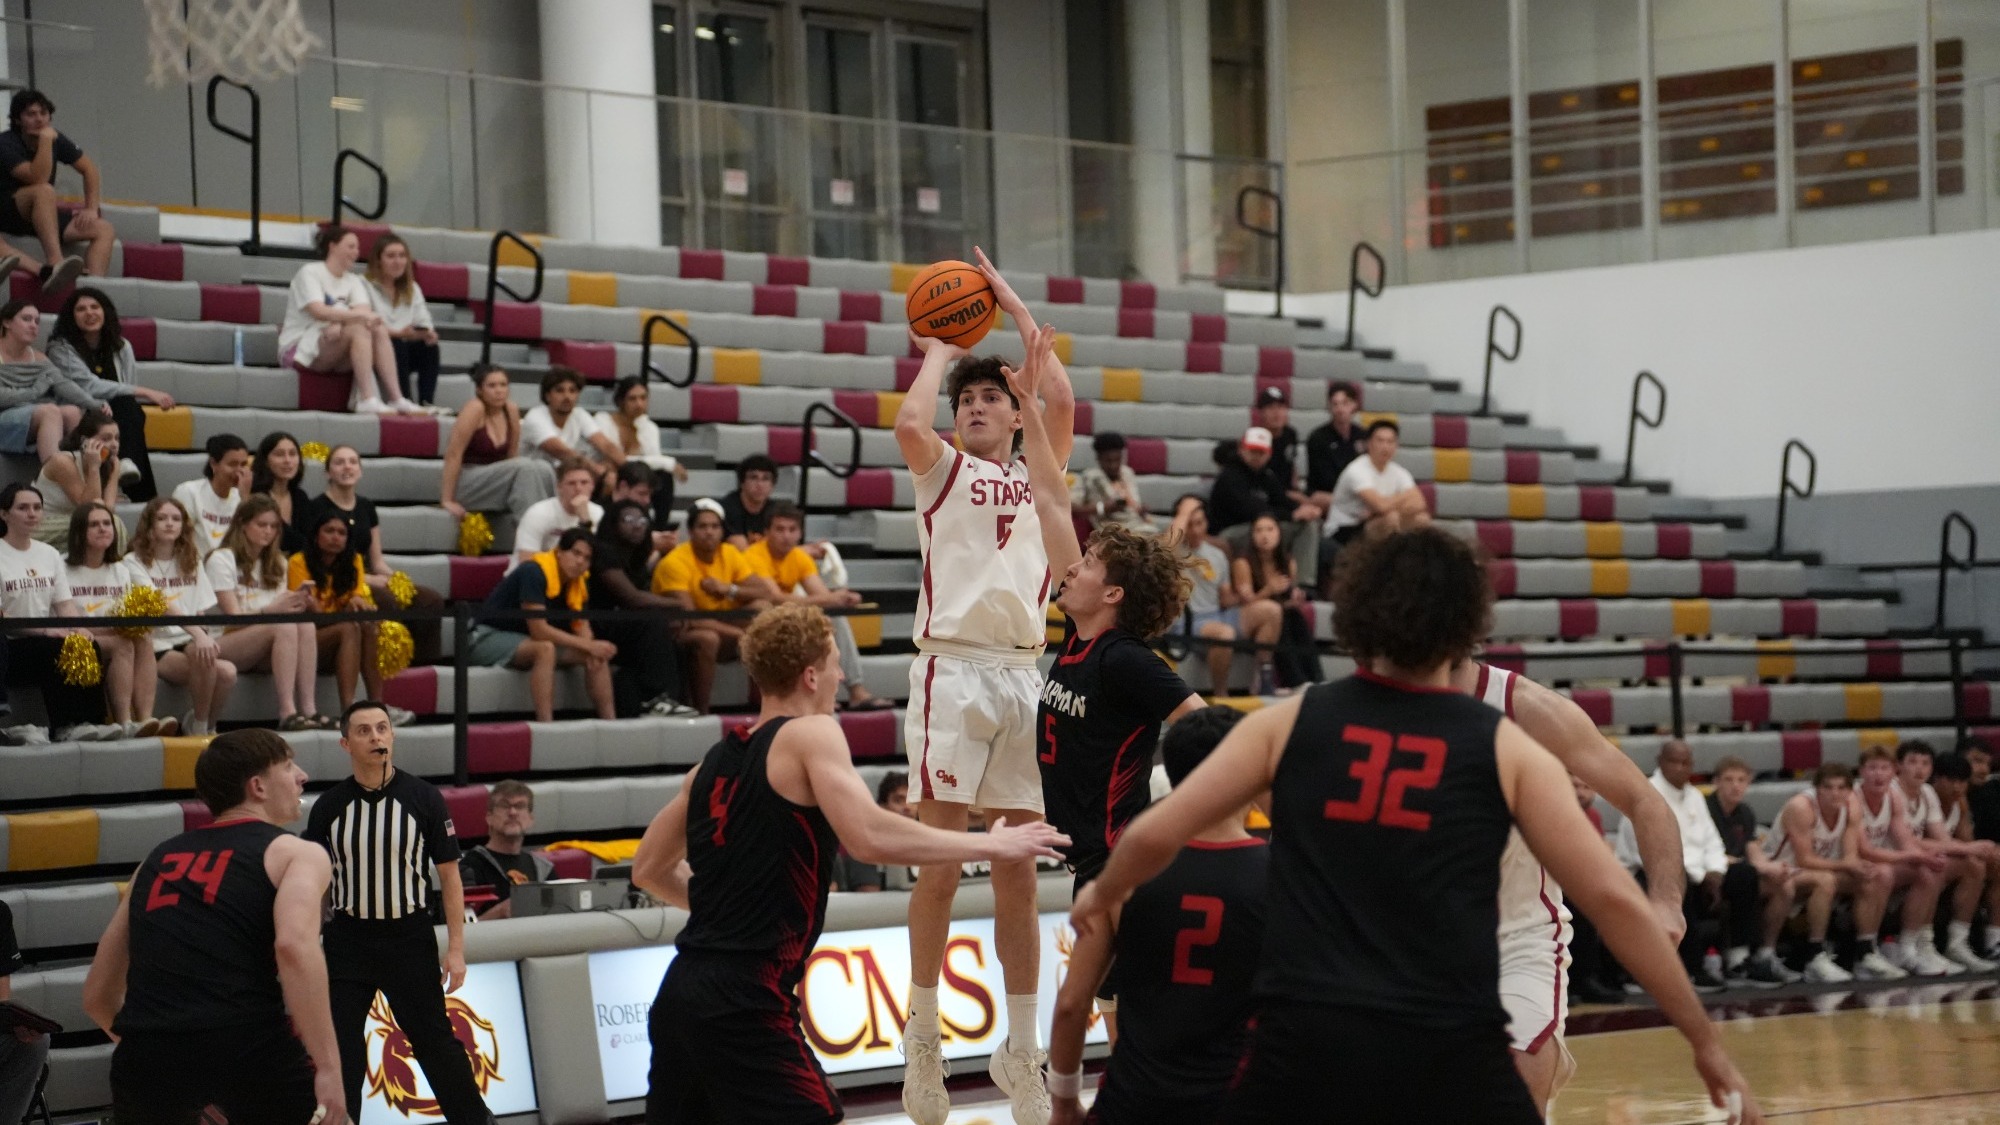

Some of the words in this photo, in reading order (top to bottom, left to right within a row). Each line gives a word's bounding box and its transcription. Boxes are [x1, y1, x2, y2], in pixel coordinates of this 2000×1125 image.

[928, 298, 987, 330] Wilson
[996, 514, 1017, 551] 5
[5, 580, 18, 592] WE
[34, 577, 47, 588] THE
[1039, 712, 1056, 765] 5
[936, 769, 957, 788] CMS
[1323, 724, 1449, 831] 32
[709, 775, 740, 847] 4
[145, 848, 235, 913] 24
[1171, 894, 1225, 986] 2
[596, 1002, 653, 1028] ROBER
[796, 934, 996, 1060] CMS
